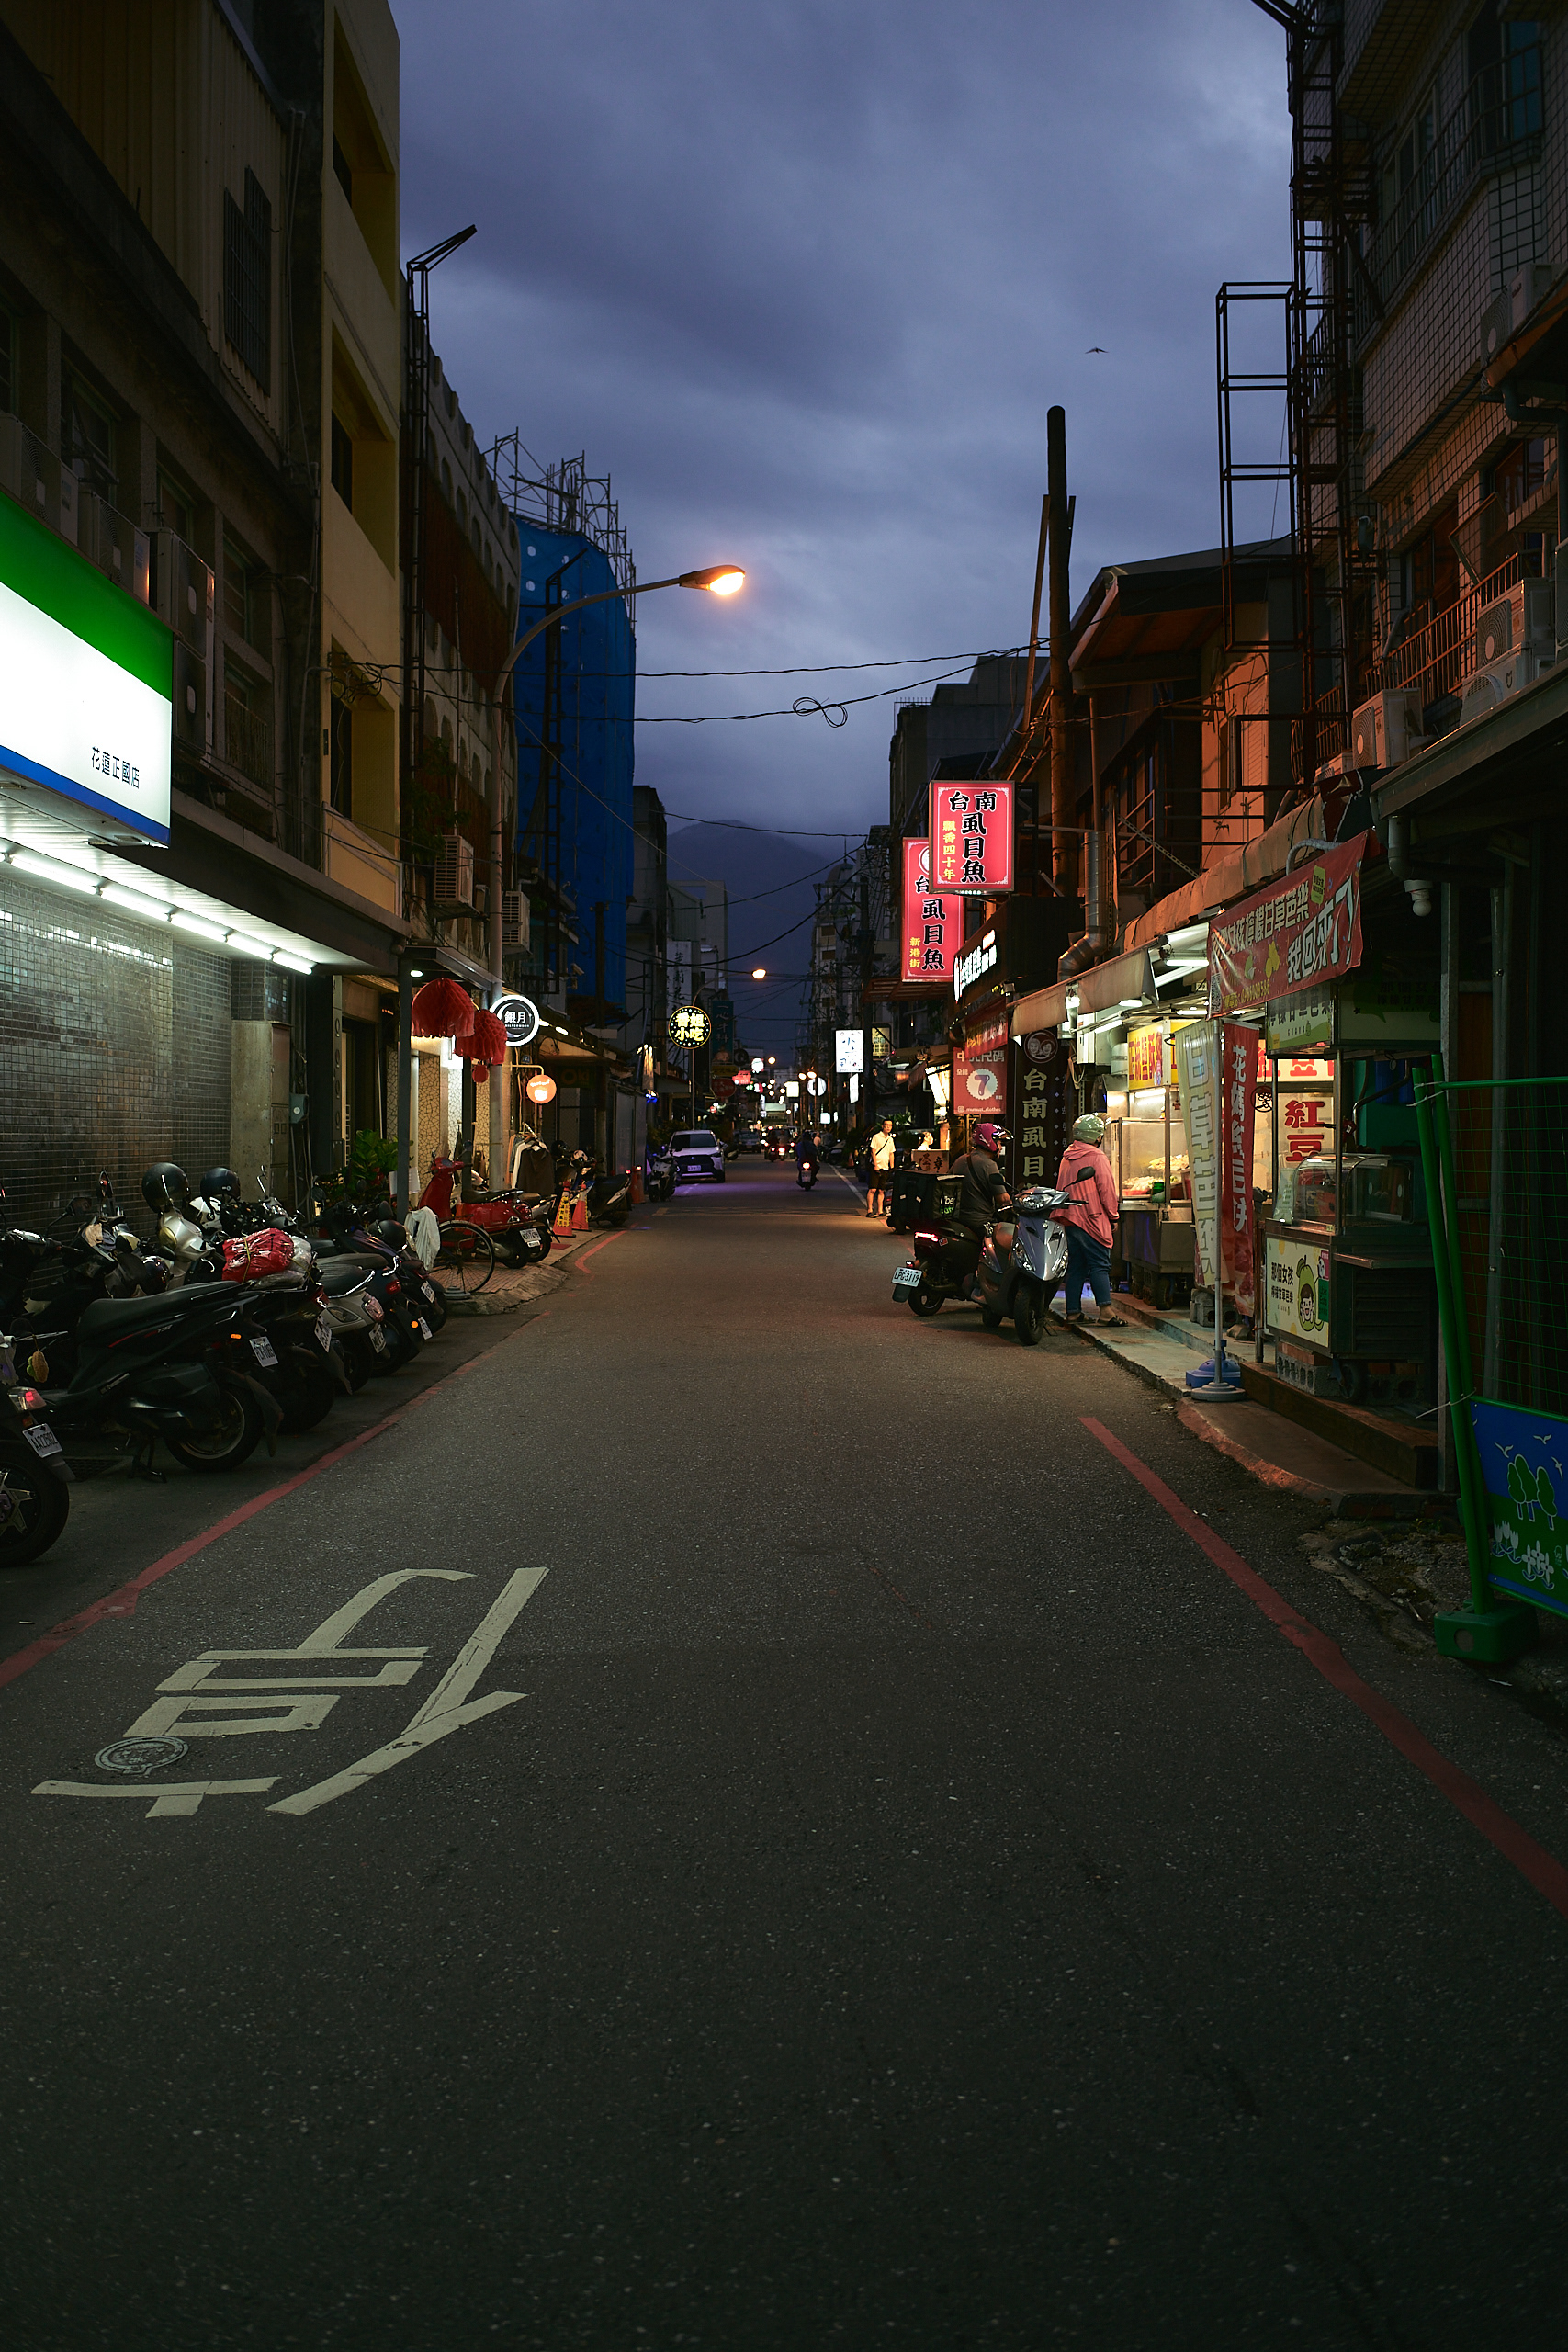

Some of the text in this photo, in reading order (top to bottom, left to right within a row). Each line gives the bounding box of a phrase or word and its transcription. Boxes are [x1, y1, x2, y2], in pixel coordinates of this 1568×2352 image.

[92, 745, 140, 789] 花蓮正國店
[949, 791, 997, 812] 台南
[942, 820, 956, 880] 飄香四十年
[961, 812, 987, 883] 虱目魚
[909, 937, 921, 967] 新港街
[921, 899, 946, 970] 虱目魚
[504, 1010, 527, 1023] 銀月
[674, 1027, 705, 1042] 小吃
[1021, 1068, 1048, 1191] 台南虱目
